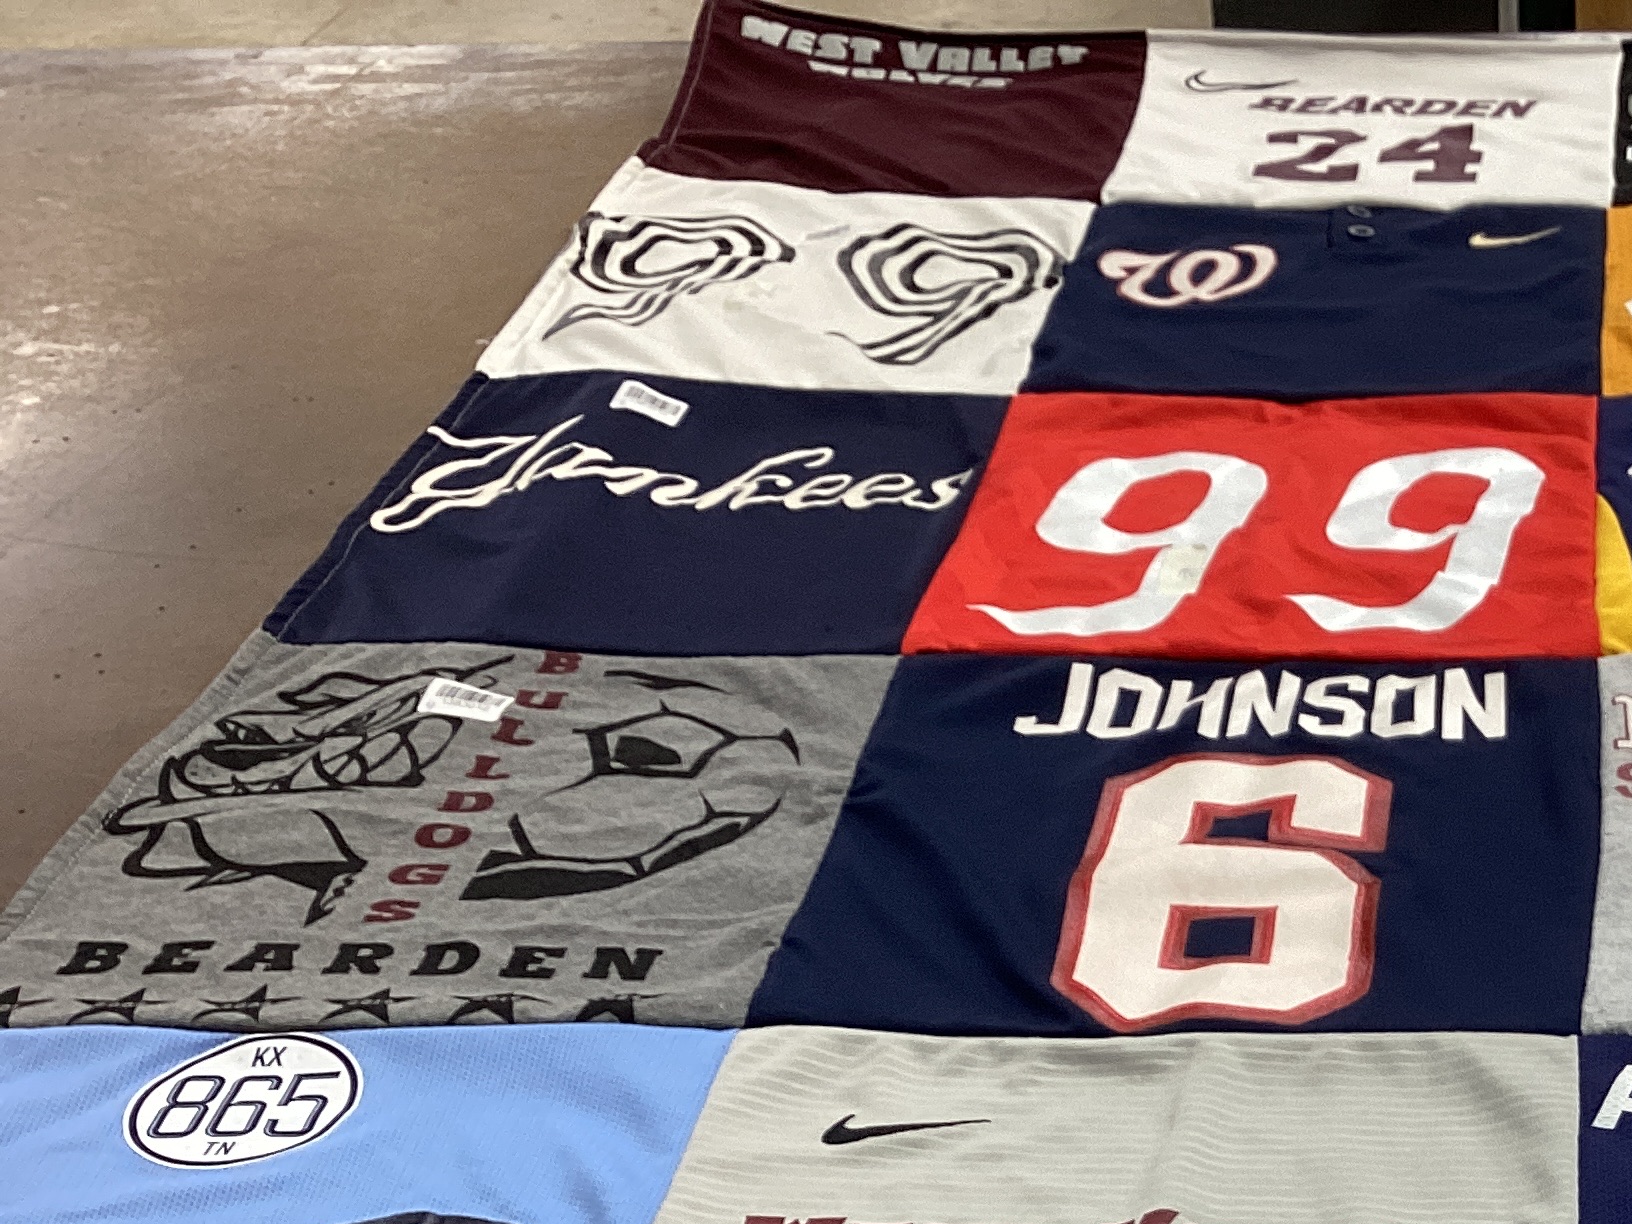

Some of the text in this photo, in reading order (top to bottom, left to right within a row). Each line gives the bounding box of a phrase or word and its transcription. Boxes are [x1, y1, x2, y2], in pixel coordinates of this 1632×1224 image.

[741, 16, 1089, 73] WEST VALLEY
[1252, 124, 1484, 182] 24
[540, 210, 1064, 365] 99
[369, 414, 976, 533] Yankees
[966, 446, 1547, 637] 99
[1012, 662, 1508, 740] JOHNSON
[1049, 751, 1395, 1034] 6
[55, 939, 664, 981] BEARDEN
[251, 1046, 288, 1069] KX
[145, 1070, 342, 1139] 865
[201, 1141, 237, 1156] TN
